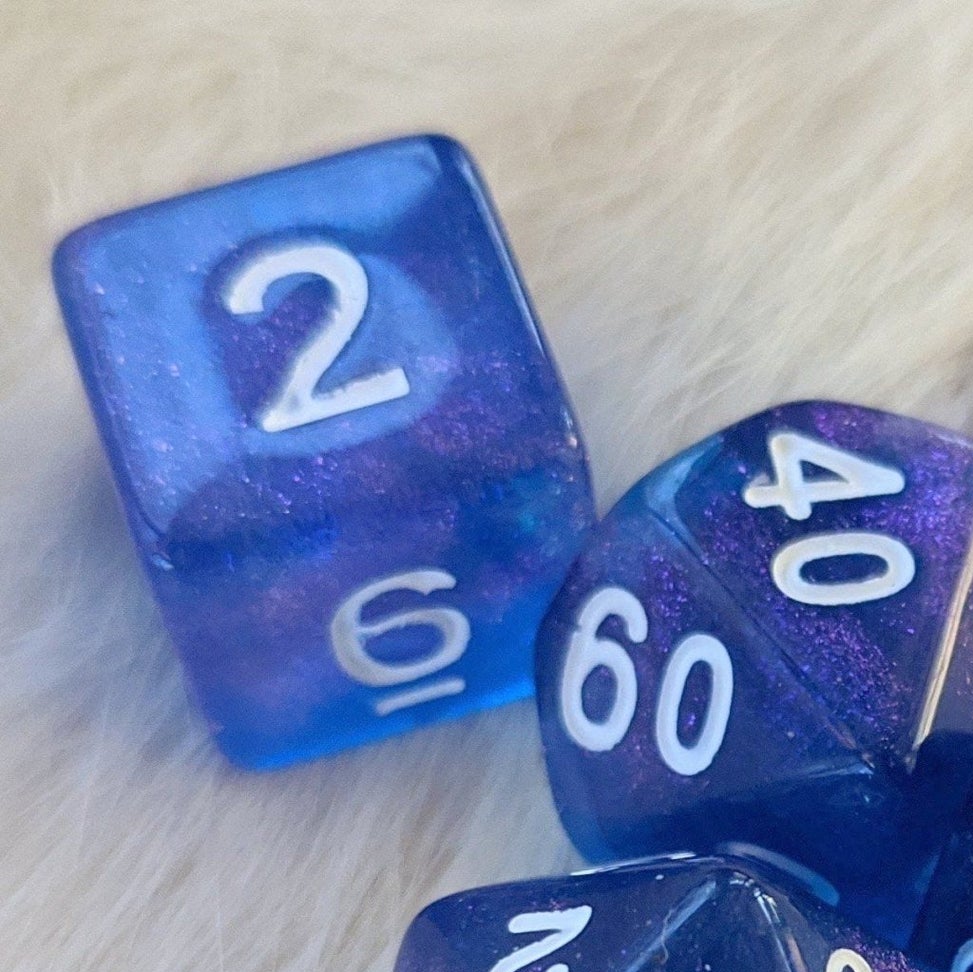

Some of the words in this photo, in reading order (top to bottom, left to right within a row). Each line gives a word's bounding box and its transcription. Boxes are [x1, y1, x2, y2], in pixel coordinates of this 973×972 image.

[224, 243, 410, 432] 2
[744, 432, 916, 606] 40
[331, 569, 470, 715] 6
[561, 587, 734, 776] 60
